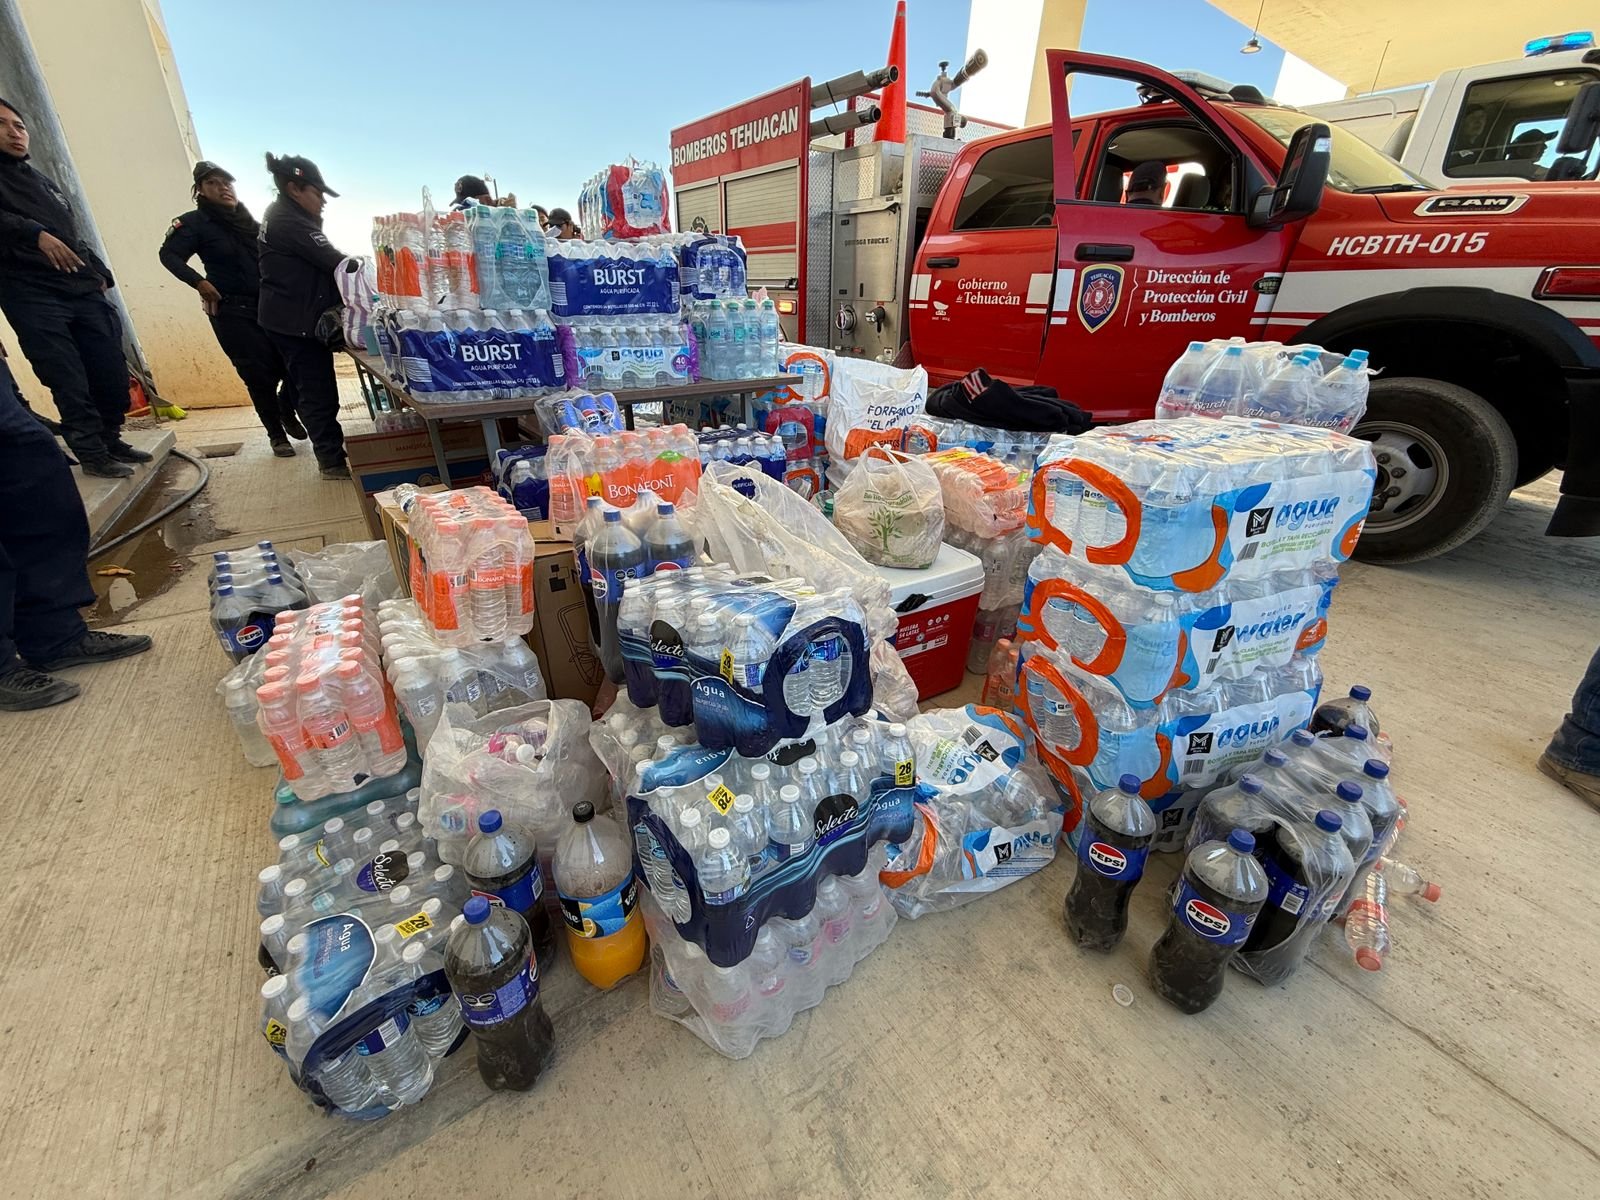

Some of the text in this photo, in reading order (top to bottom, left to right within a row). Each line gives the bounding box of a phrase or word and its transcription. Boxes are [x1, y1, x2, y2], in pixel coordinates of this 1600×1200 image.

[673, 106, 799, 167] BOMBEROS TEHUACAN
[1438, 198, 1508, 207] RAM
[1327, 232, 1489, 256] HCBTH-015
[593, 268, 645, 286] BURST
[957, 278, 1008, 290] Gobierno
[1146, 269, 1231, 284] Dirección de
[964, 291, 1021, 306] Tehuacán
[1142, 290, 1248, 304] Protección Civil
[1138, 310, 1216, 326] y Bomberos
[461, 343, 522, 362] BURST
[675, 356, 685, 364] 40
[608, 474, 674, 499] BONAFONT
[1275, 496, 1340, 531] agua
[238, 629, 263, 642] PEPSI
[1235, 612, 1306, 643] water
[696, 681, 725, 698] Agua
[695, 750, 726, 765] Agua
[899, 762, 912, 776] 28
[717, 792, 732, 810] 28
[875, 797, 901, 811] Agua
[814, 805, 859, 840] Selecto
[1090, 847, 1125, 868] PEPSI
[374, 854, 397, 890] Selecto
[410, 915, 430, 929] 28
[1188, 903, 1227, 931] PEPSI
[338, 923, 354, 952] Agua
[270, 1024, 287, 1037] 28
